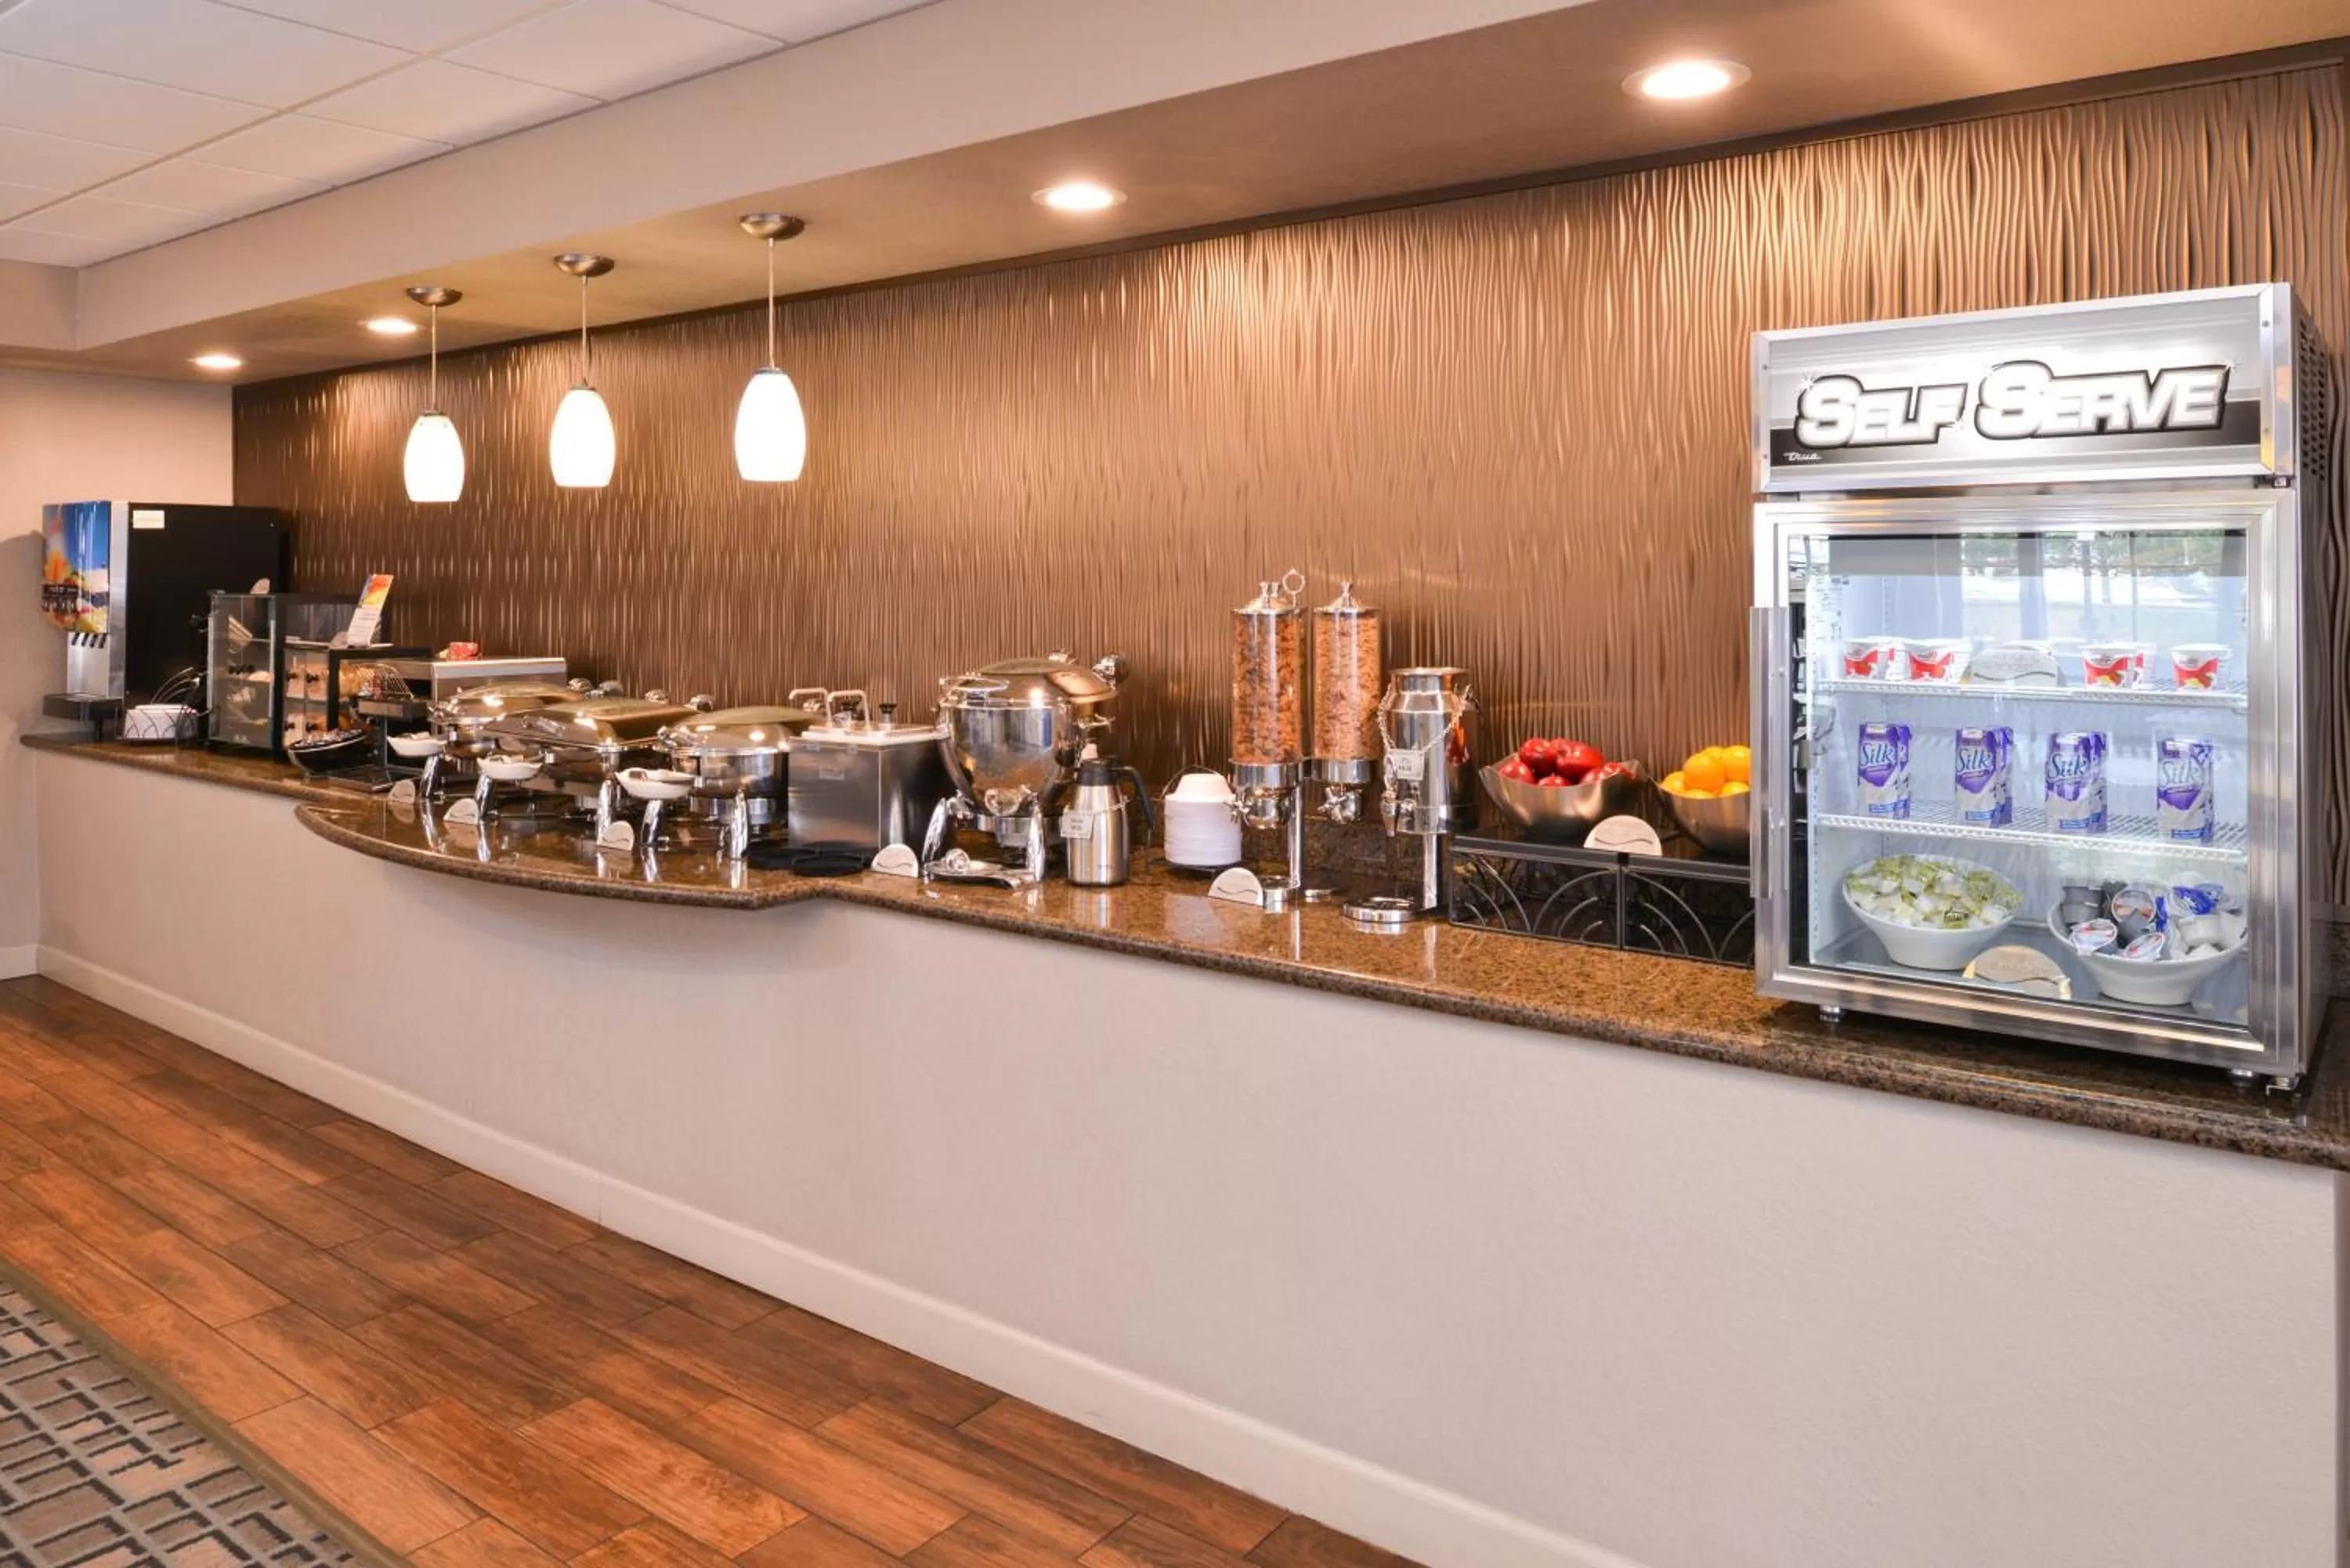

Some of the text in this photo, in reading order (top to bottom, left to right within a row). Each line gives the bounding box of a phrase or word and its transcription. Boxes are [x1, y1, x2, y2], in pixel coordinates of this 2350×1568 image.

[1794, 359, 2230, 450] SELF SERVE
[1860, 742, 1896, 767] Silk
[1957, 748, 1994, 773] Silk
[2047, 753, 2089, 779] Silk
[2161, 760, 2202, 786] Silk
